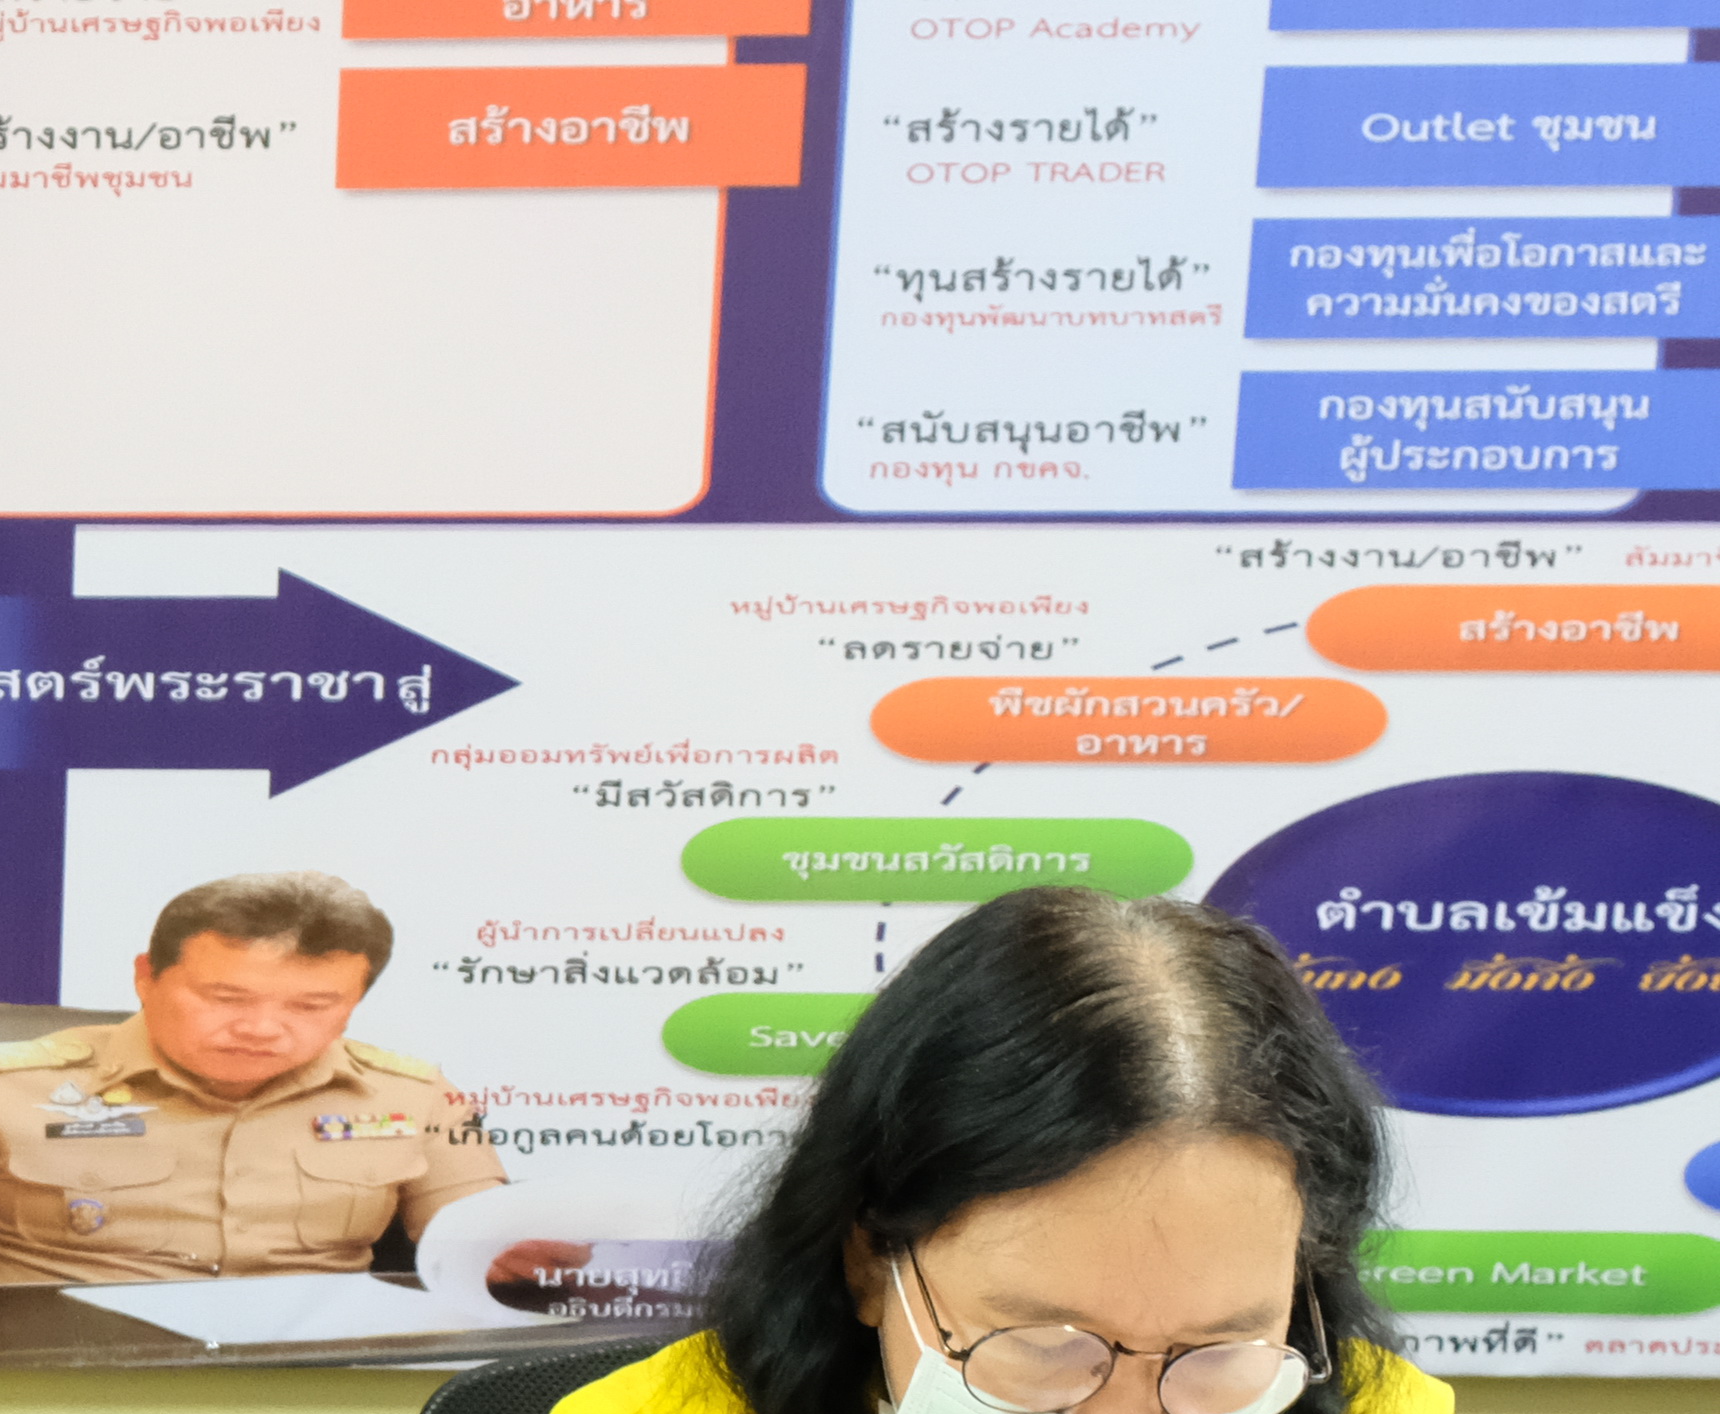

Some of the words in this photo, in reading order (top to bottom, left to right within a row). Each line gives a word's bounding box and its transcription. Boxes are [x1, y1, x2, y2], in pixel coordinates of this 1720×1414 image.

[911, 18, 1015, 40] OTOP
[1030, 18, 1200, 43] Academy
[449, 104, 689, 145] สร้างอาชีพ
[1362, 112, 1514, 141] Outlet
[1532, 115, 1656, 152] ชุมชน
[906, 162, 1011, 184] OTOP
[1028, 162, 1165, 182] TRADER
[1291, 227, 1706, 278] กองทุนเพื่อโอกาสและ
[1306, 275, 1683, 320] ความมั่นคงของสตรี
[882, 304, 1222, 334] กองทุนพัฒนาบทบาทสตรี
[1320, 385, 1649, 431] กองทุนสนับสนุน
[1340, 434, 1618, 482] ผู้ประกอบการ
[870, 462, 978, 487] กองทุน
[1626, 546, 1720, 566] สัมมา
[730, 594, 1088, 621] หมู่บ้านเศรษฐกิจพอเพียง
[1460, 610, 1679, 641] สร้างอาชีพ
[431, 739, 838, 771] กลุ่มออมทรัพย์เพื่อการผลิต
[1077, 734, 1206, 754] อาหาร
[782, 843, 1089, 882] ชุมชนสวัสดิการ
[477, 916, 784, 948] ผู้นำการเปลี่ยนแปลง
[443, 1086, 817, 1114] หมู่บ้านเศรษฐกิจพอเพีย
[1492, 1262, 1645, 1285] Market
